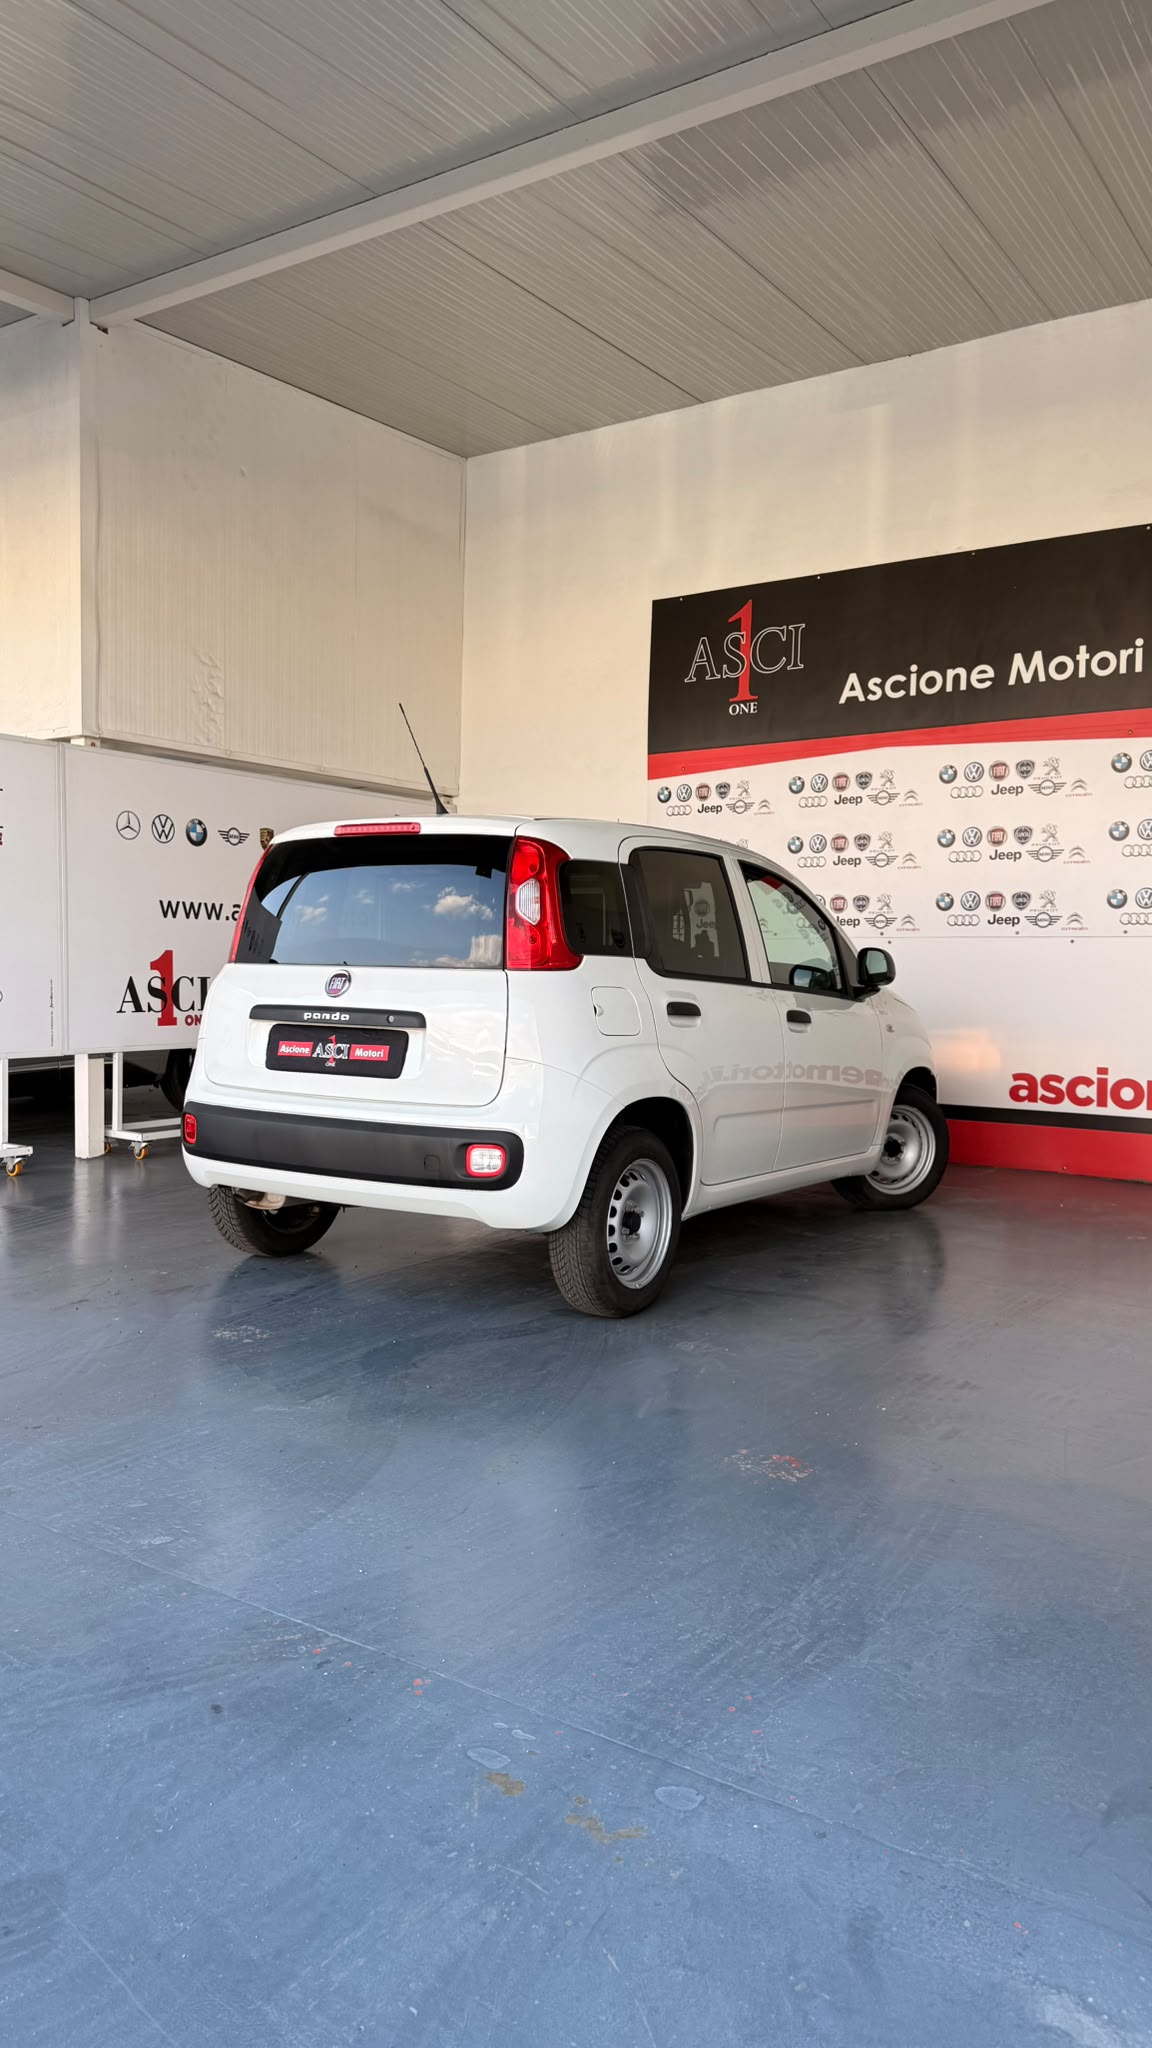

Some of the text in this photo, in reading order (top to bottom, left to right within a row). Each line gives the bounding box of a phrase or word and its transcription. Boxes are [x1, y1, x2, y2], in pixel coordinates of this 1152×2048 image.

[684, 624, 805, 682] ASCI
[839, 638, 1144, 704] Ascione Motori
[729, 702, 757, 716] ONE
[991, 784, 1024, 796] Jeep
[834, 794, 863, 806] Jeep
[697, 803, 722, 814] Jeep
[833, 855, 861, 867] Jeep
[989, 849, 1022, 862] Jeep
[987, 914, 1020, 927] Jeep
[330, 977, 346, 990] FIAT
[185, 1015, 203, 1026] ON
[303, 1011, 350, 1021] panda
[280, 1042, 384, 1059] Ascione ASCI Motori
[1009, 1066, 1152, 1111] ascio
